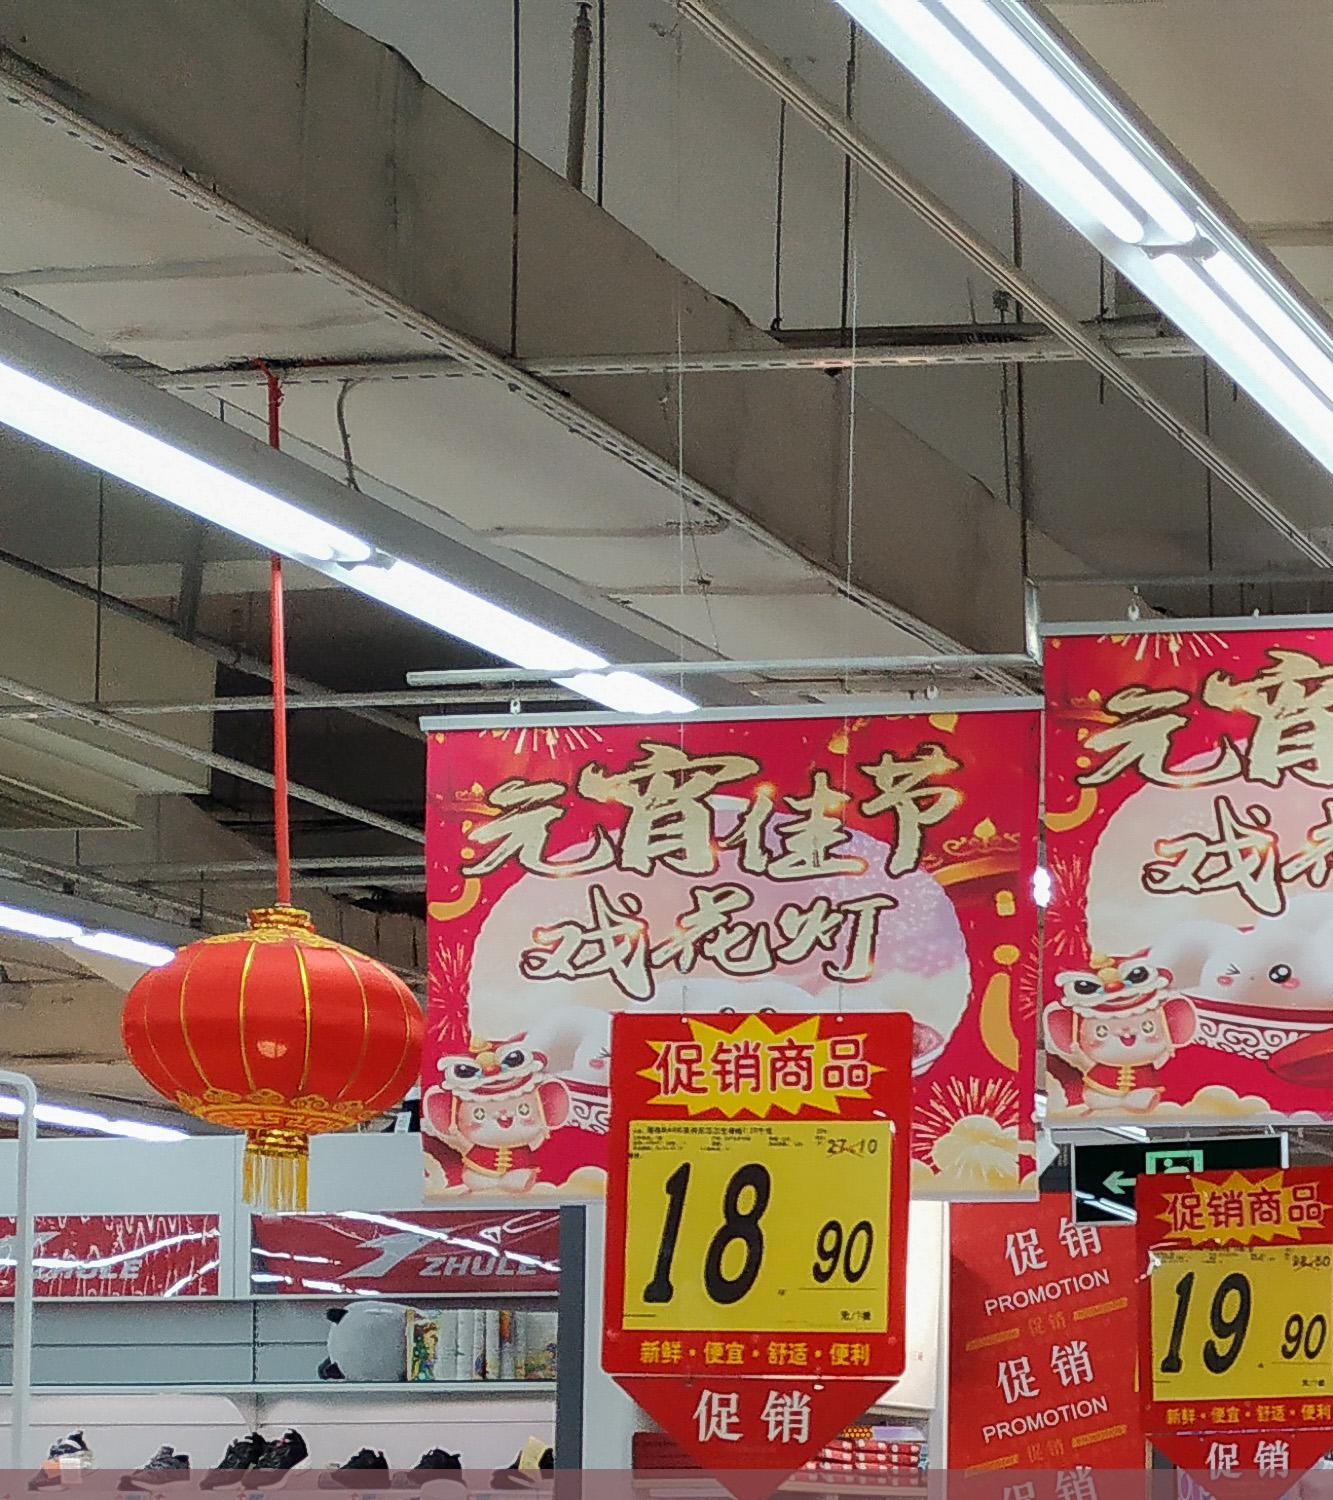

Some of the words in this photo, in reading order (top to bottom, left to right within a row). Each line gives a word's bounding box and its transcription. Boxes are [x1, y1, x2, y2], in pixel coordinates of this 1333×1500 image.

[463, 742, 963, 880] 元宵佳节
[519, 887, 899, 1000] 戏花灯
[655, 1034, 873, 1096] 促销商品
[1169, 1184, 1325, 1232] 促销商品
[418, 1254, 541, 1277] ZHULE
[1005, 1217, 1101, 1277] 促销
[985, 1268, 1110, 1317] PROMOTION
[998, 1340, 1095, 1404] 促销
[693, 1388, 811, 1444] 促销
[982, 1396, 1108, 1444] PROMOTION
[1205, 1440, 1290, 1481] 促销
